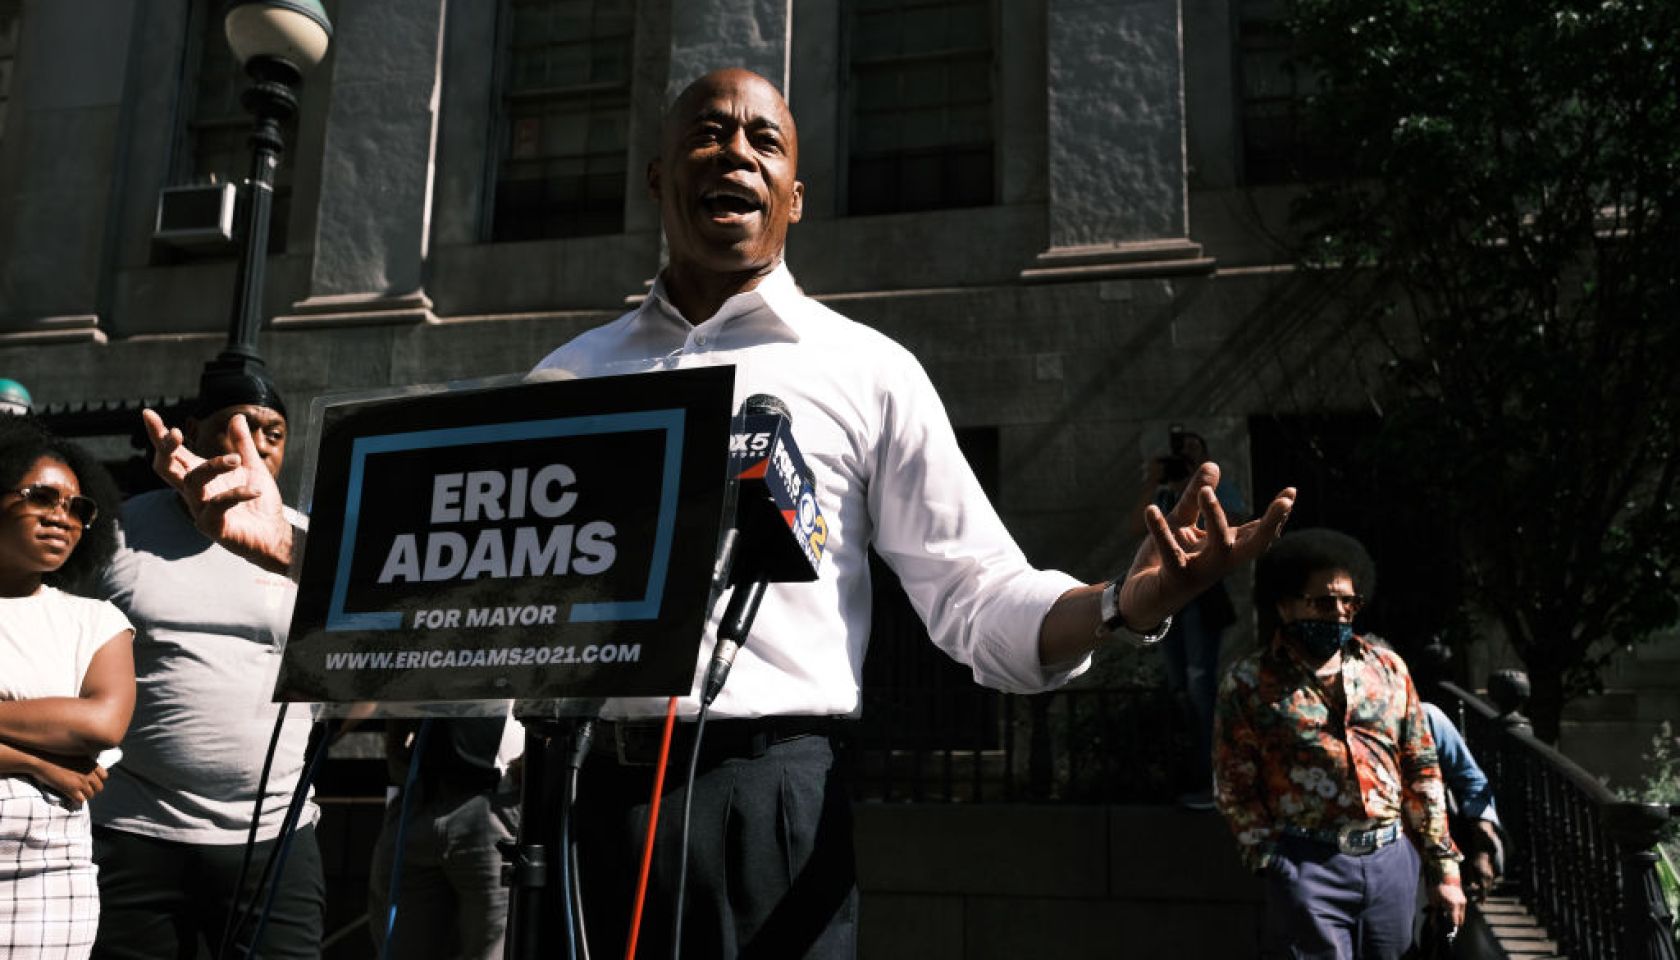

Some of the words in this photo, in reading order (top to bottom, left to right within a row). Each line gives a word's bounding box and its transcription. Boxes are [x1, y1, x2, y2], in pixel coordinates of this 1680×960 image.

[430, 464, 578, 523] ERIC
[378, 521, 617, 583] ADAMS
[413, 608, 462, 629] FOR
[465, 604, 557, 628] MAYOR
[325, 643, 642, 670] WWW.ERICADAMS2021.COM
